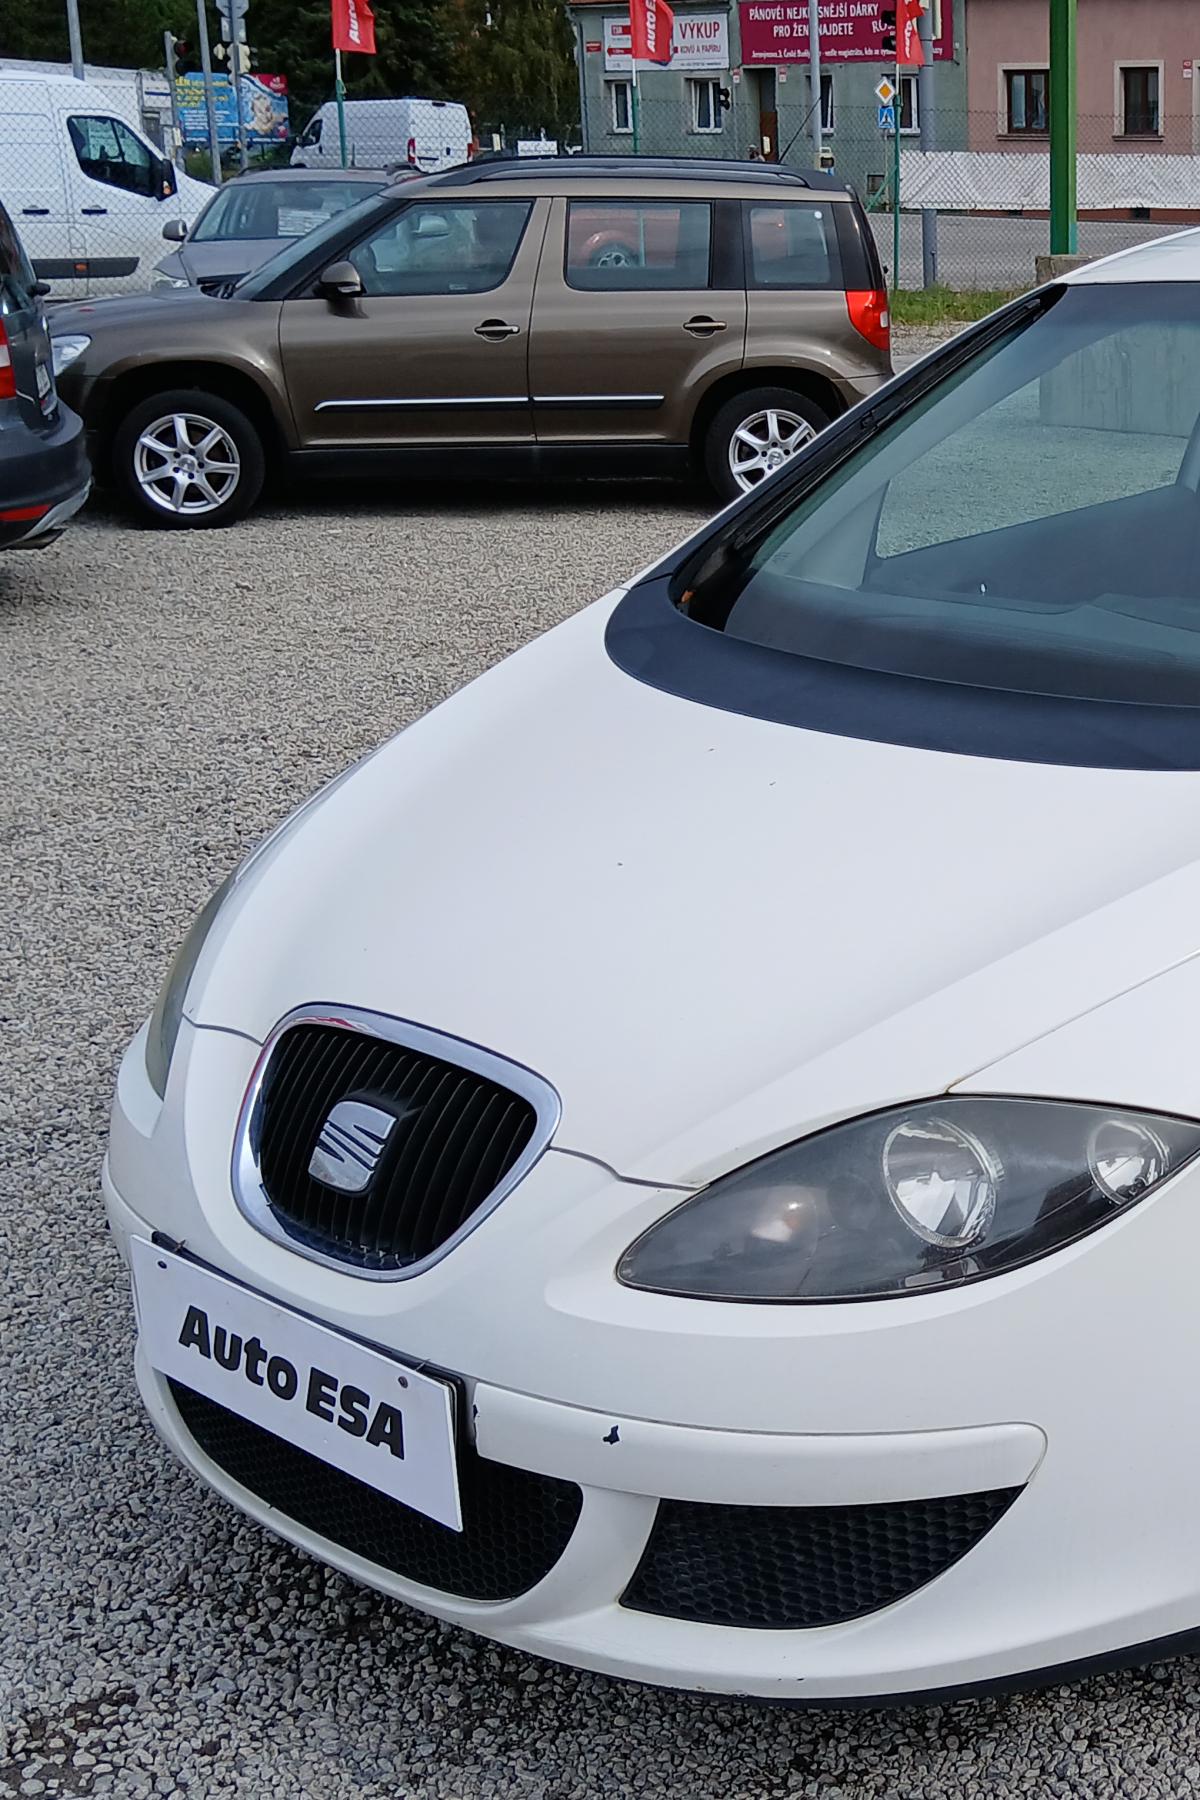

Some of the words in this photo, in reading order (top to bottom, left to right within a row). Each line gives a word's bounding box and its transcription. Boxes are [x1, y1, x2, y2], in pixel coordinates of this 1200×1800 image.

[786, 3, 848, 19] NEJKSNĚJŠÍ
[850, 3, 879, 17] DÁRKY
[679, 19, 720, 39] VÝKUP
[773, 25, 791, 37] PRO
[792, 22, 809, 37] ŽEN
[178, 1304, 298, 1400] Auto
[305, 1366, 405, 1460] ESA
